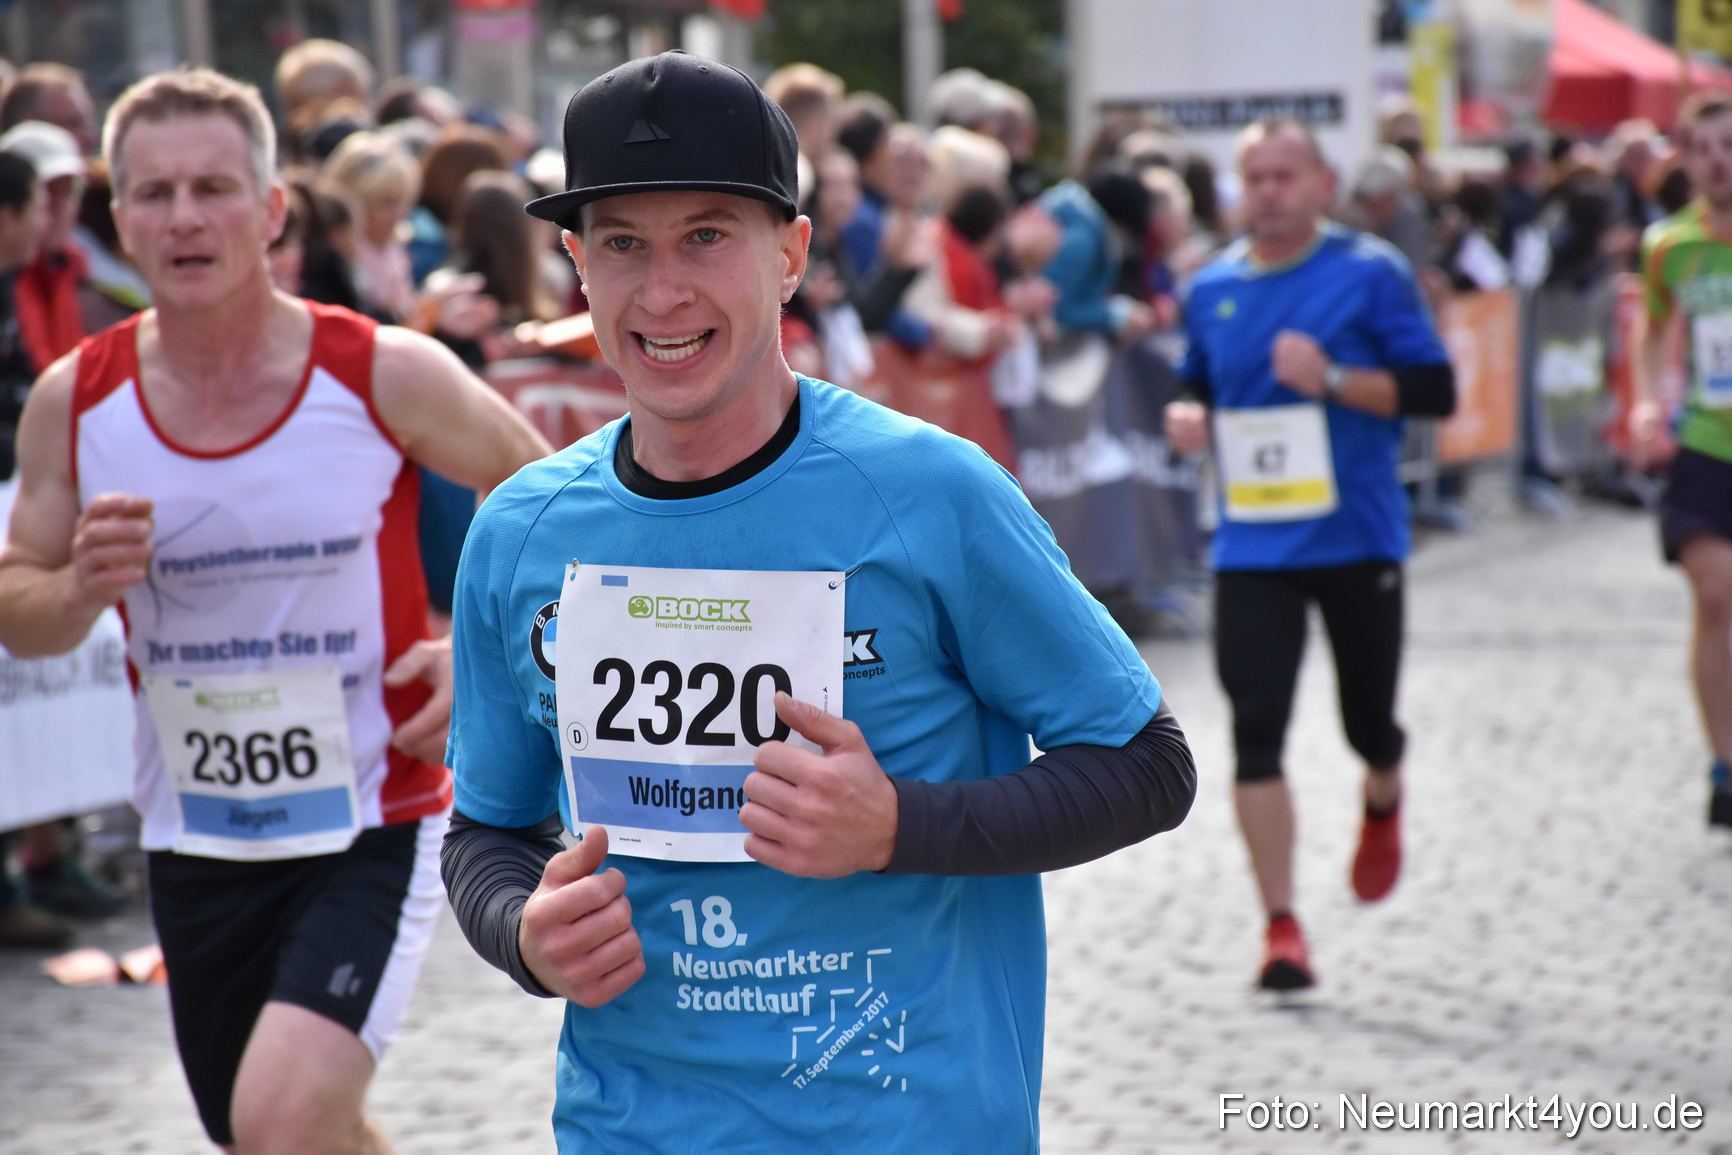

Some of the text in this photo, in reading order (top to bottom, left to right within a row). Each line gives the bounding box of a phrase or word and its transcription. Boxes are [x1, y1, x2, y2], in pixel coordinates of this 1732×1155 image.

[656, 597, 751, 622] BOCK
[655, 620, 753, 632] inspired by smart concepts
[279, 631, 317, 655] Sie
[843, 666, 886, 680] oncepts
[592, 657, 793, 747] 2320
[573, 729, 582, 744] D
[185, 726, 319, 788] 2366
[670, 895, 748, 948] 18.
[672, 949, 854, 980] Neumarkter
[676, 983, 817, 1016] Stadtlauf
[862, 991, 889, 1022] 2017
